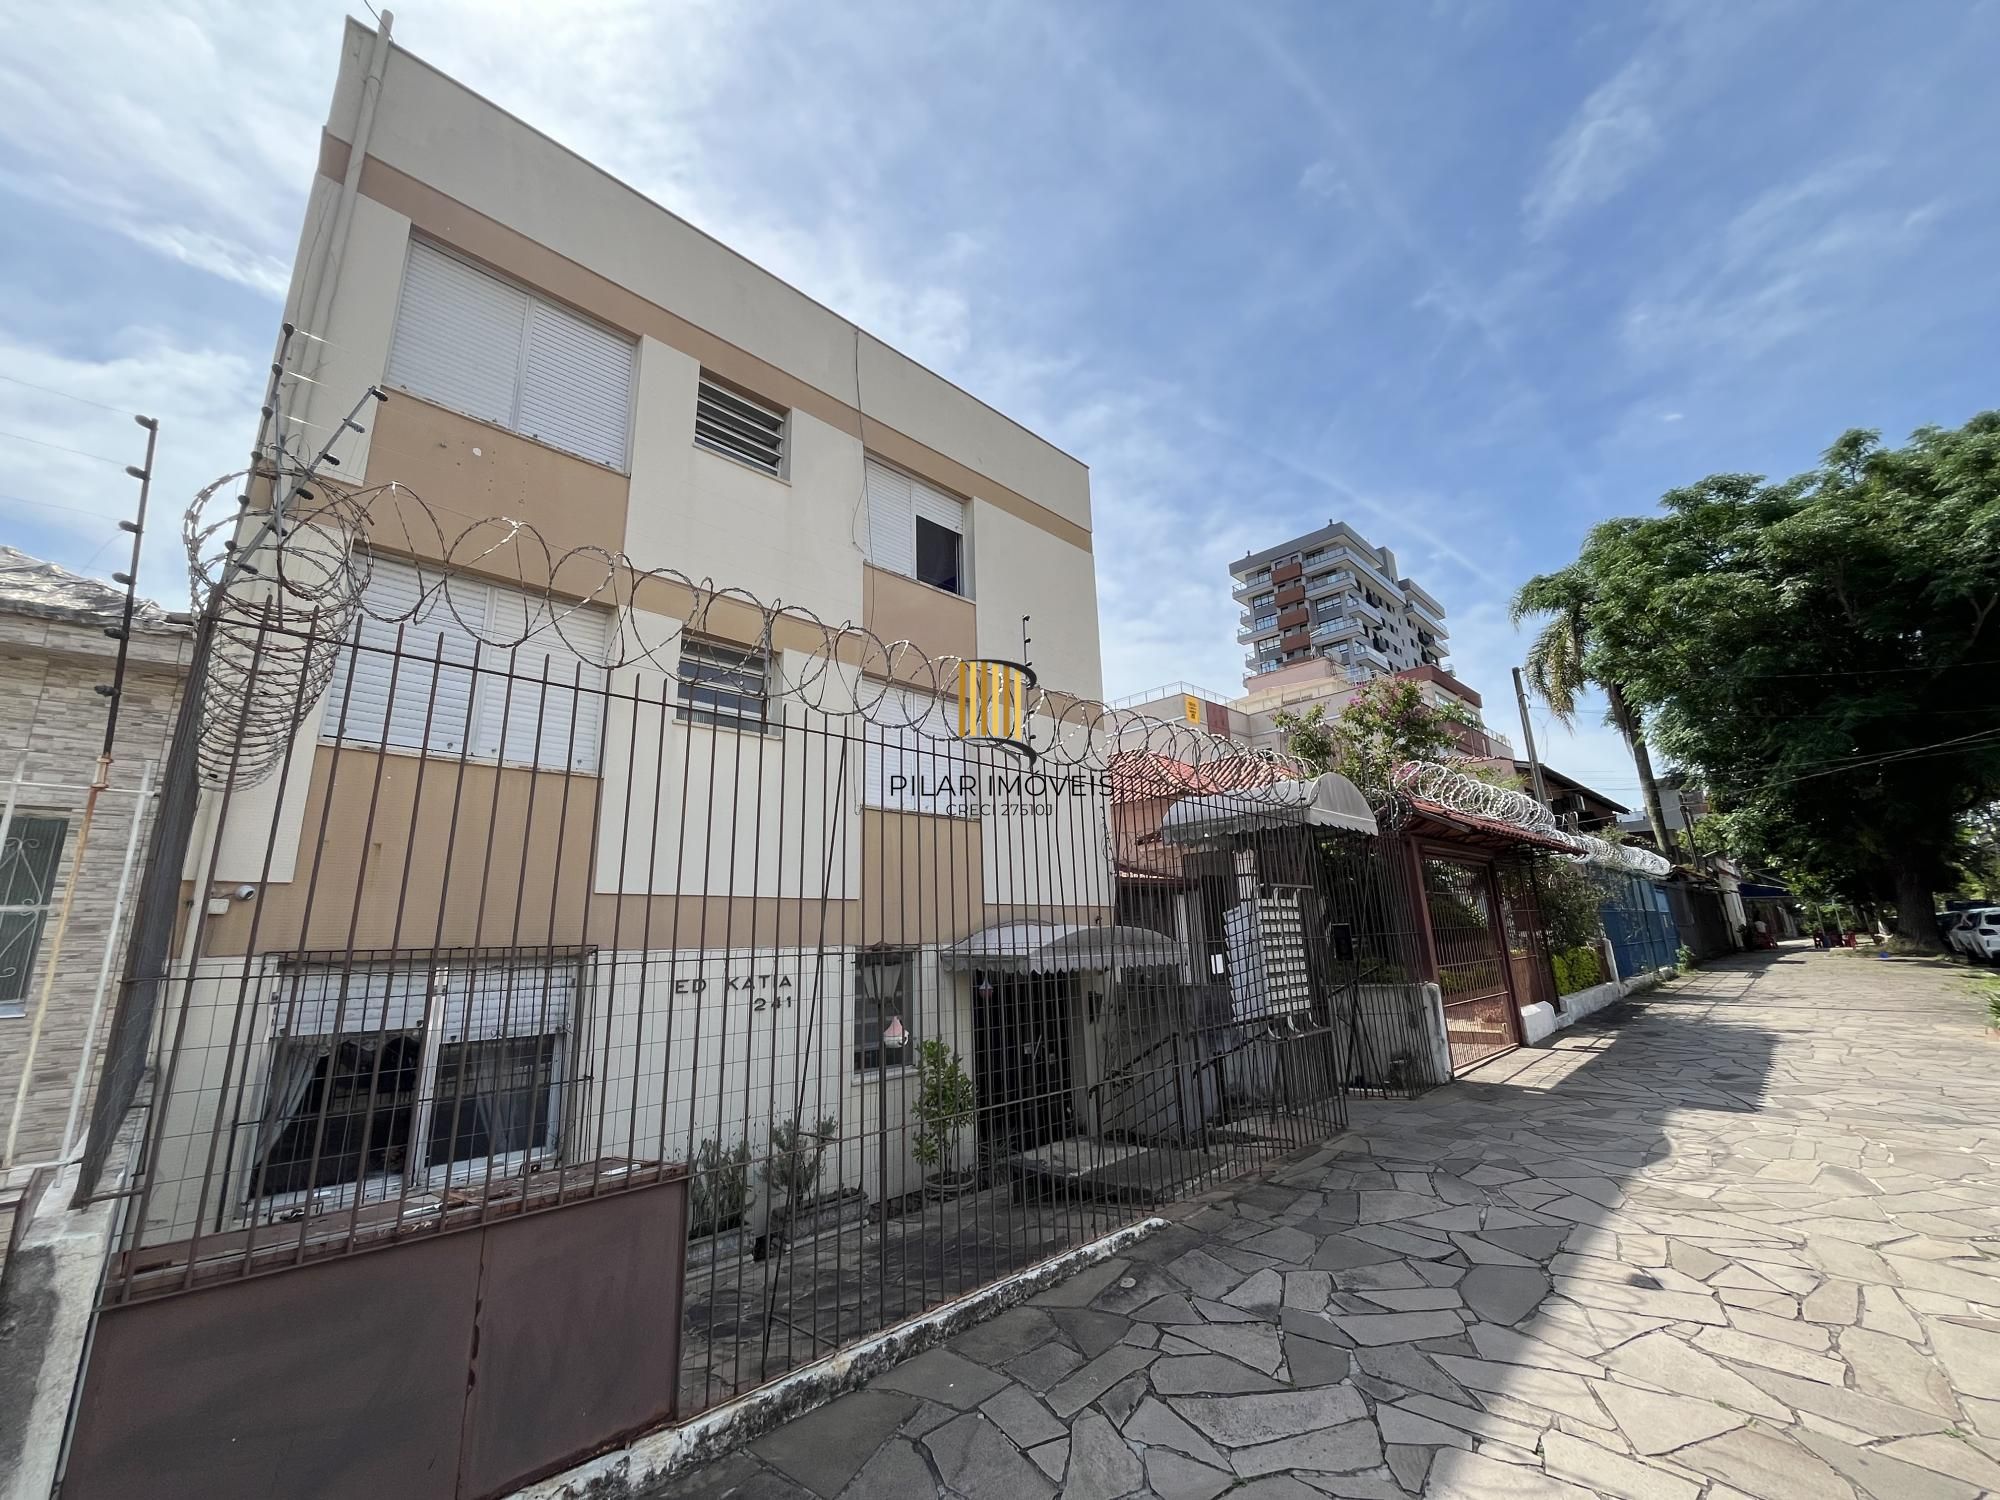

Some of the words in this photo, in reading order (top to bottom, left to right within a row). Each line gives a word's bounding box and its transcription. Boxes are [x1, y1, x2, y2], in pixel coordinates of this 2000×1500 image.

[675, 978, 706, 994] ED
[726, 974, 792, 991] KATA
[754, 996, 791, 1012] 241
